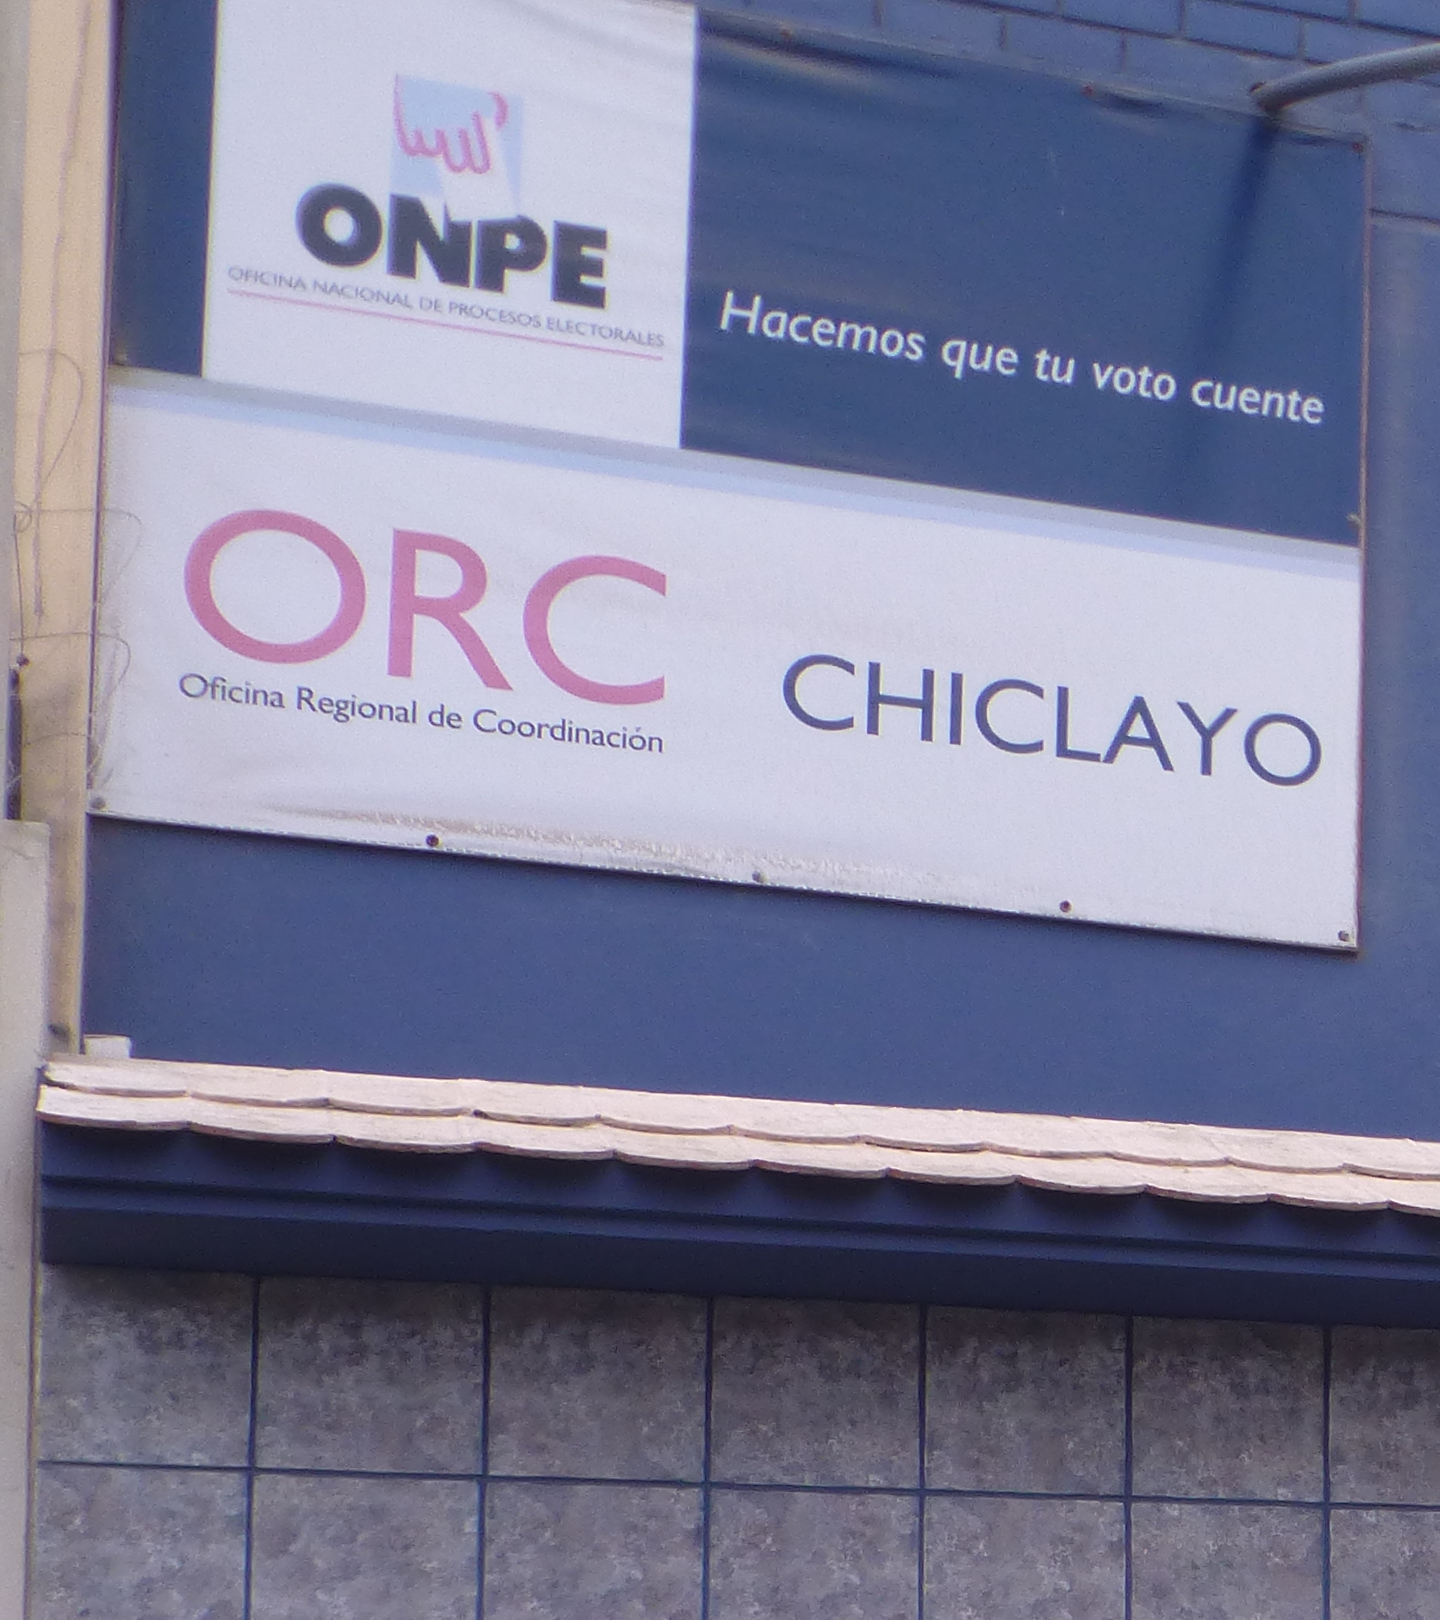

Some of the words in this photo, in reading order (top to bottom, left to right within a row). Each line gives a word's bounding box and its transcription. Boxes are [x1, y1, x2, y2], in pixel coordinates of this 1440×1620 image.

[228, 266, 306, 290] OFICINA
[313, 280, 413, 308] NACIONAL
[420, 296, 441, 313] DE
[450, 300, 541, 329] PROCESOS
[546, 316, 665, 347] ELECTORALES
[296, 183, 608, 309] ONPE
[720, 290, 926, 361] Hacemos
[941, 338, 1019, 380] que
[1035, 348, 1075, 384] tu
[1093, 362, 1177, 400] voto
[1191, 379, 1325, 424] cuente
[183, 509, 667, 706] ORC
[179, 673, 285, 708] Oficina
[296, 686, 417, 723] Regional
[428, 704, 463, 729] de
[473, 707, 663, 753] Coordinación
[782, 654, 1322, 786] CHICLAYO
